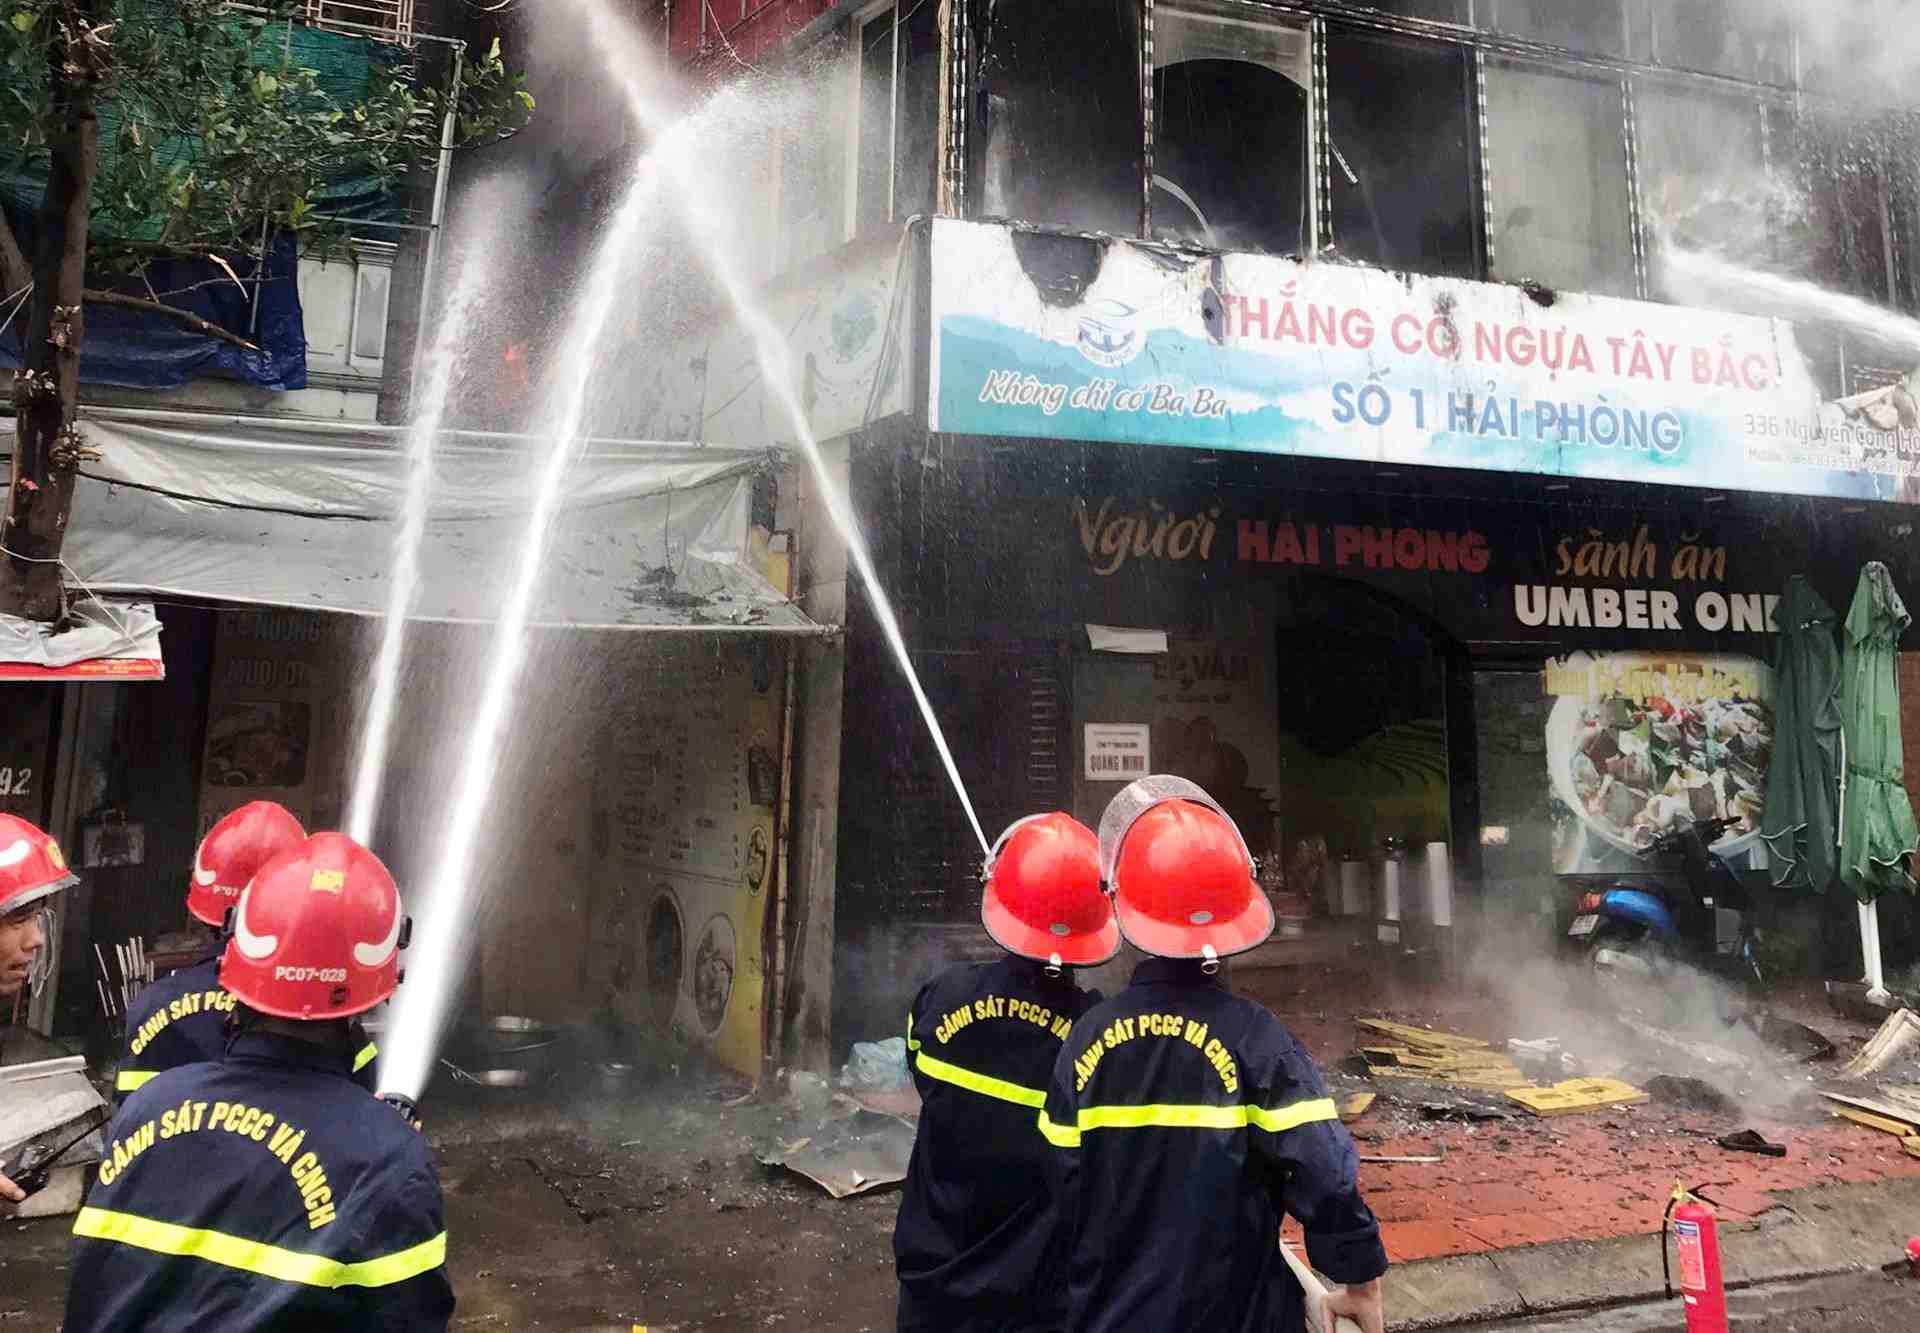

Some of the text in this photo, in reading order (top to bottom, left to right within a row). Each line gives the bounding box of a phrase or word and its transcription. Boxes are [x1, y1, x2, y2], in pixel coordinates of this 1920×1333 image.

[1224, 280, 1374, 350] THẮNG
[1474, 321, 1596, 381] NGỰA
[1606, 329, 1677, 382] TÂY
[1690, 333, 1769, 391] BẮC
[979, 370, 1227, 418] Không chỉ có Ba Ba
[1331, 367, 1682, 452] SỐ 1 HẢI PHÒNG
[1744, 413, 1778, 437] 336
[1555, 524, 1727, 582] sành ăn
[1514, 584, 1683, 631] UMBER
[169, 992, 201, 1021] SÁT
[935, 1005, 974, 1044] CẢNH
[974, 994, 1005, 1021] SÁT
[1008, 998, 1052, 1028] PCCC
[1103, 1018, 1135, 1049] SÁT
[1138, 1013, 1184, 1037] PCCC
[1184, 1020, 1208, 1049] VÀ
[99, 1099, 337, 1230] CẢNH SÁT PCCC VÀ CNCH
